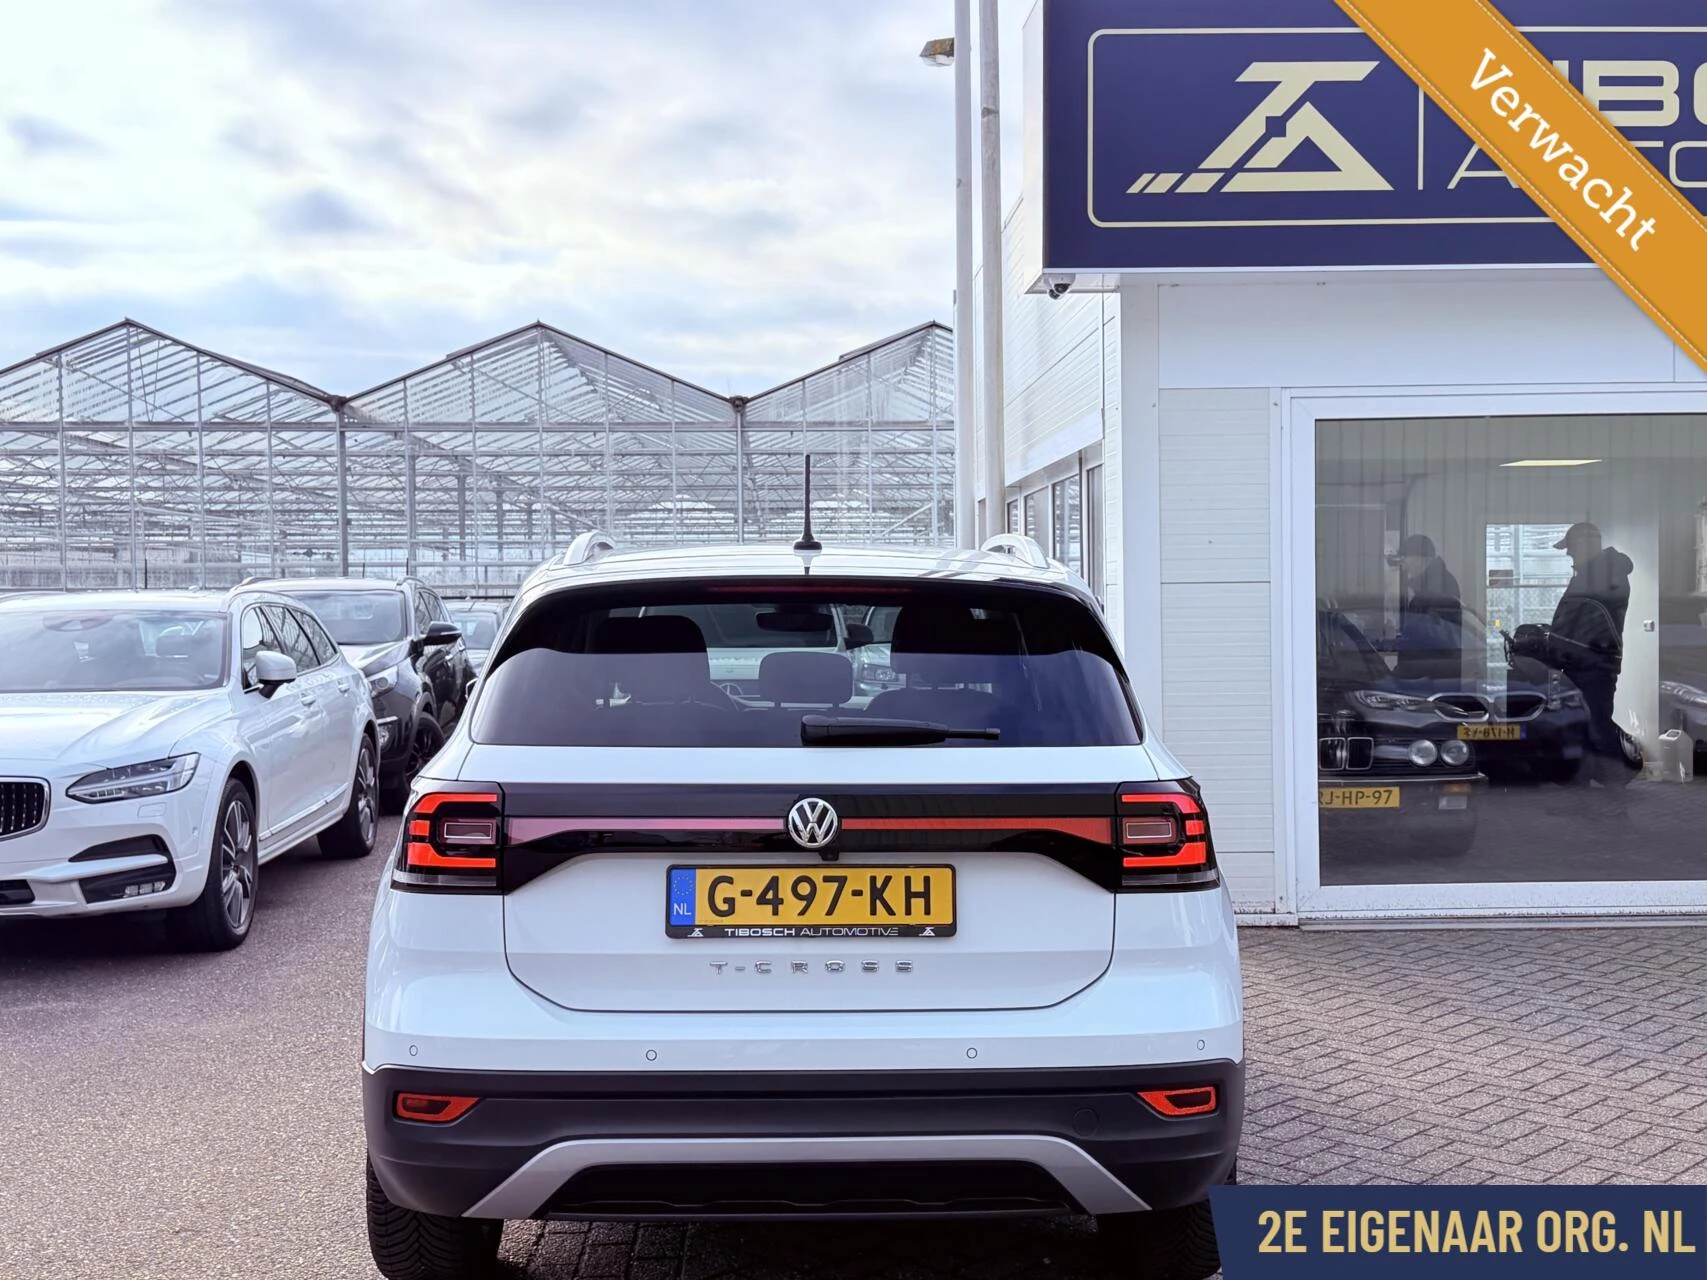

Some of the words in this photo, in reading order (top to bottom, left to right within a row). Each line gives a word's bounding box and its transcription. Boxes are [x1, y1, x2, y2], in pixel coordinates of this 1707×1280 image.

[673, 902, 692, 916] NL
[707, 874, 931, 917] G-497-KH
[724, 927, 795, 937] TIBOSCH
[800, 927, 899, 937] AUTOMOTIVE
[709, 959, 914, 975] T-CROSS
